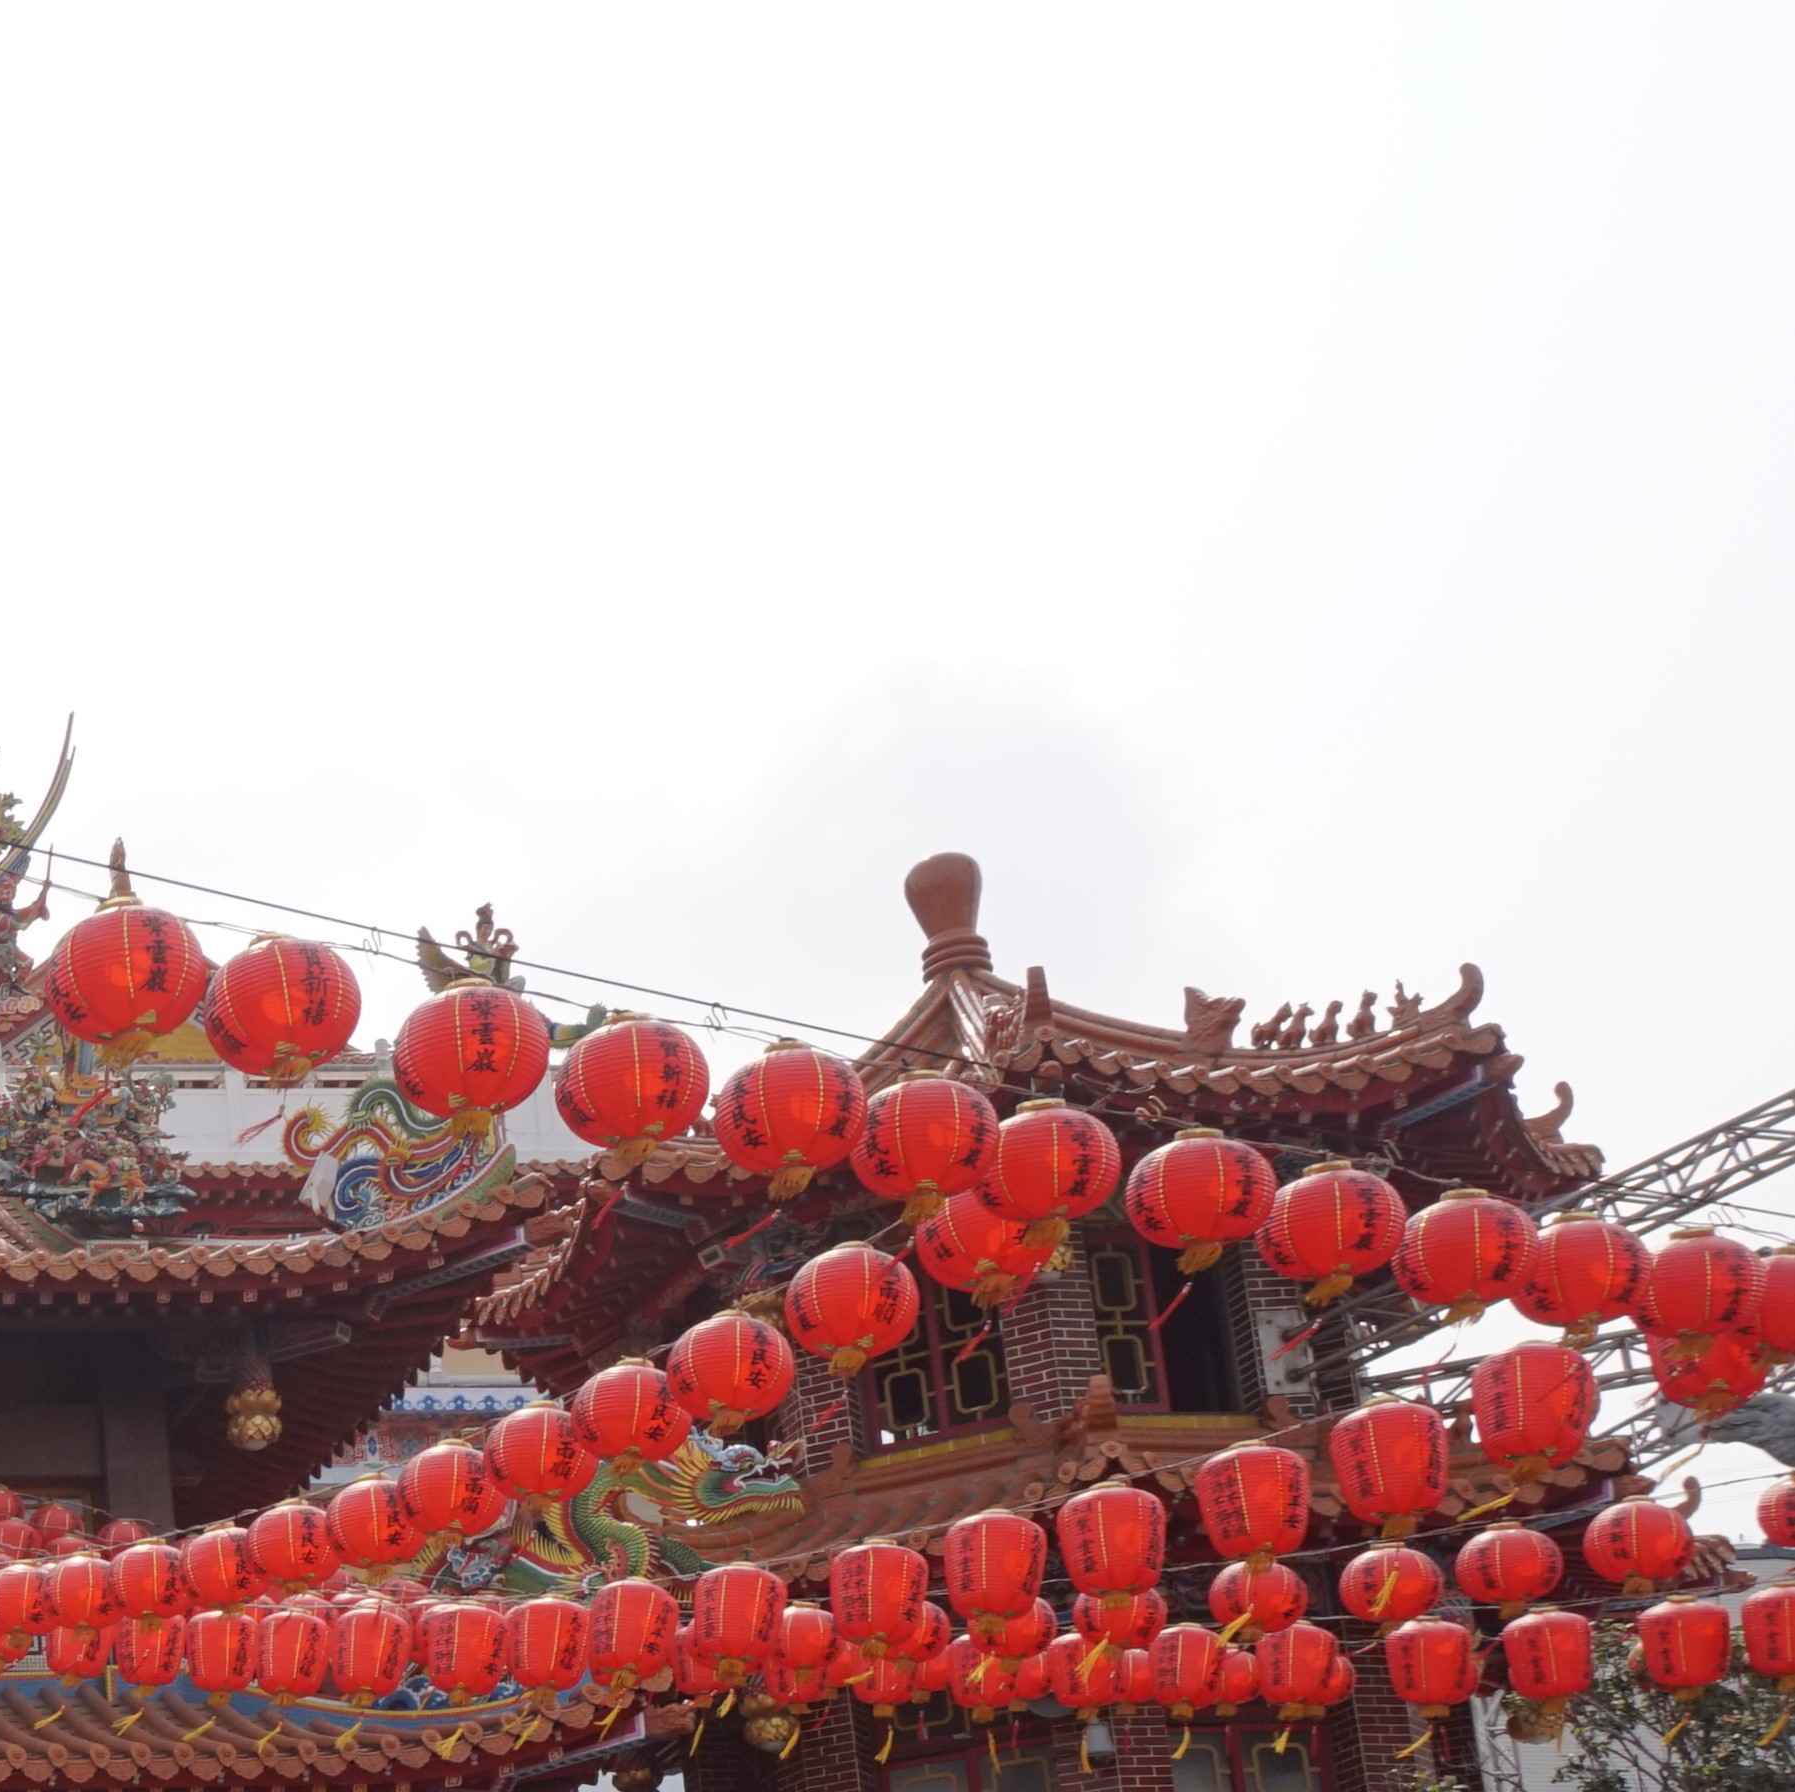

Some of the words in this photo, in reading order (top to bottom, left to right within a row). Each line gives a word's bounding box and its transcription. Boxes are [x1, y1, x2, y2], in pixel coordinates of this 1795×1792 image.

[138, 913, 175, 994] 紫雲巖
[471, 1000, 497, 1073] 紫雲巖
